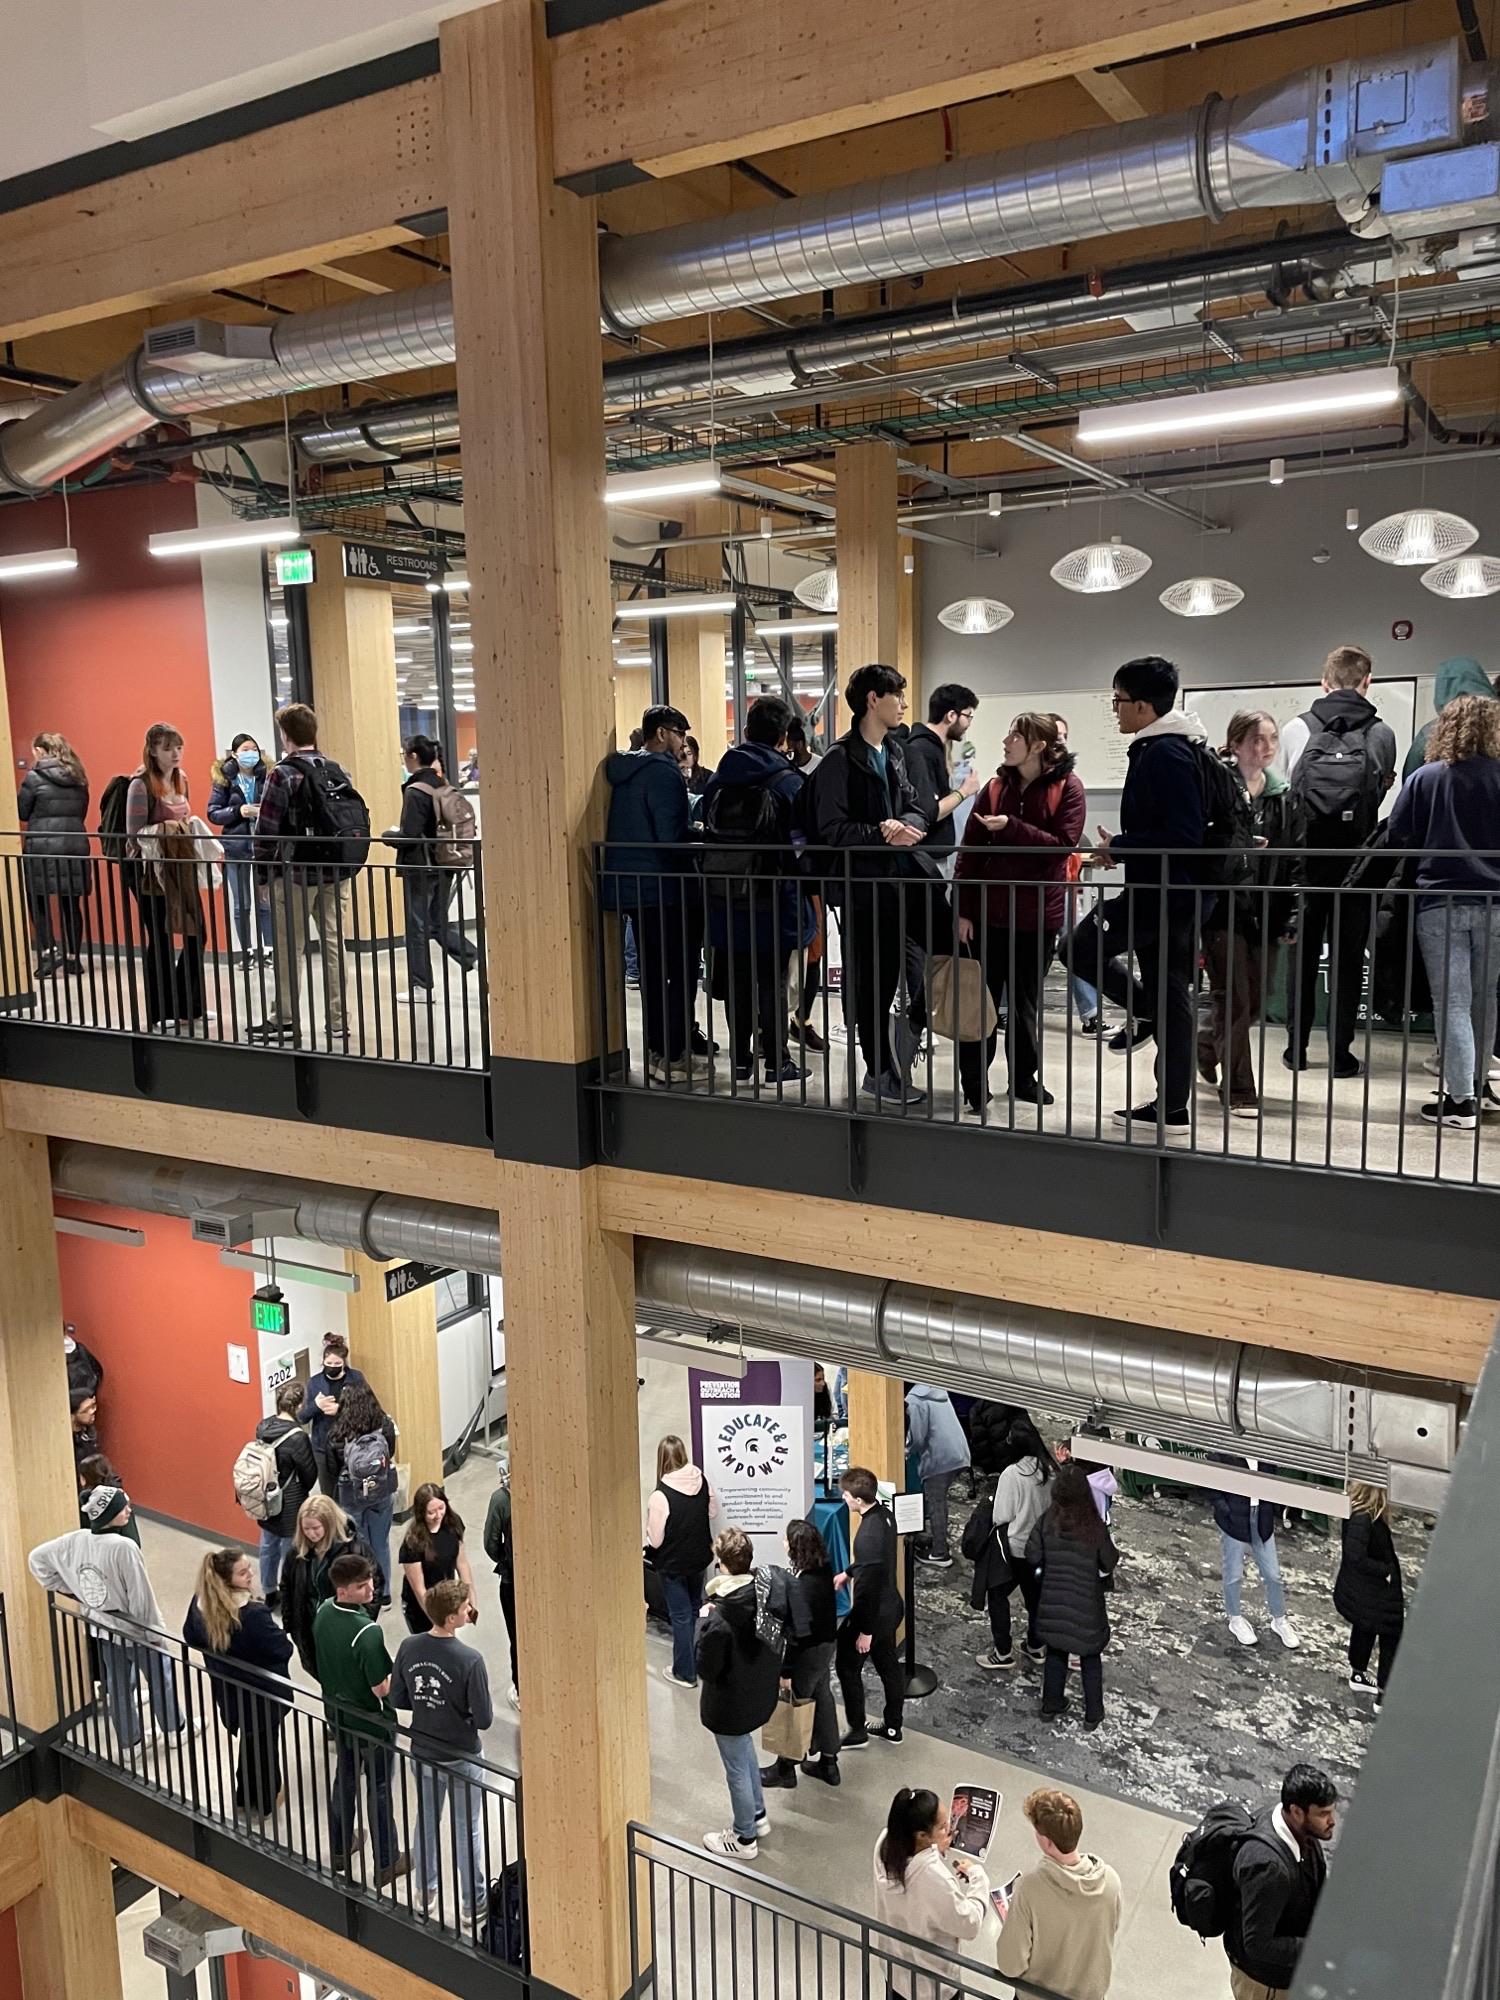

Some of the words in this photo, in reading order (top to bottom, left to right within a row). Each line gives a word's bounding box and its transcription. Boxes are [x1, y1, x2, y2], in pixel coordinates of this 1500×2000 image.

[386, 554, 438, 571] RESTROOMS
[255, 1302, 281, 1332] EXIT
[268, 1366, 292, 1388] 2202
[718, 1413, 780, 1442] EDUCATE
[773, 1433, 787, 1443] &
[717, 1445, 789, 1478] EMPOWER
